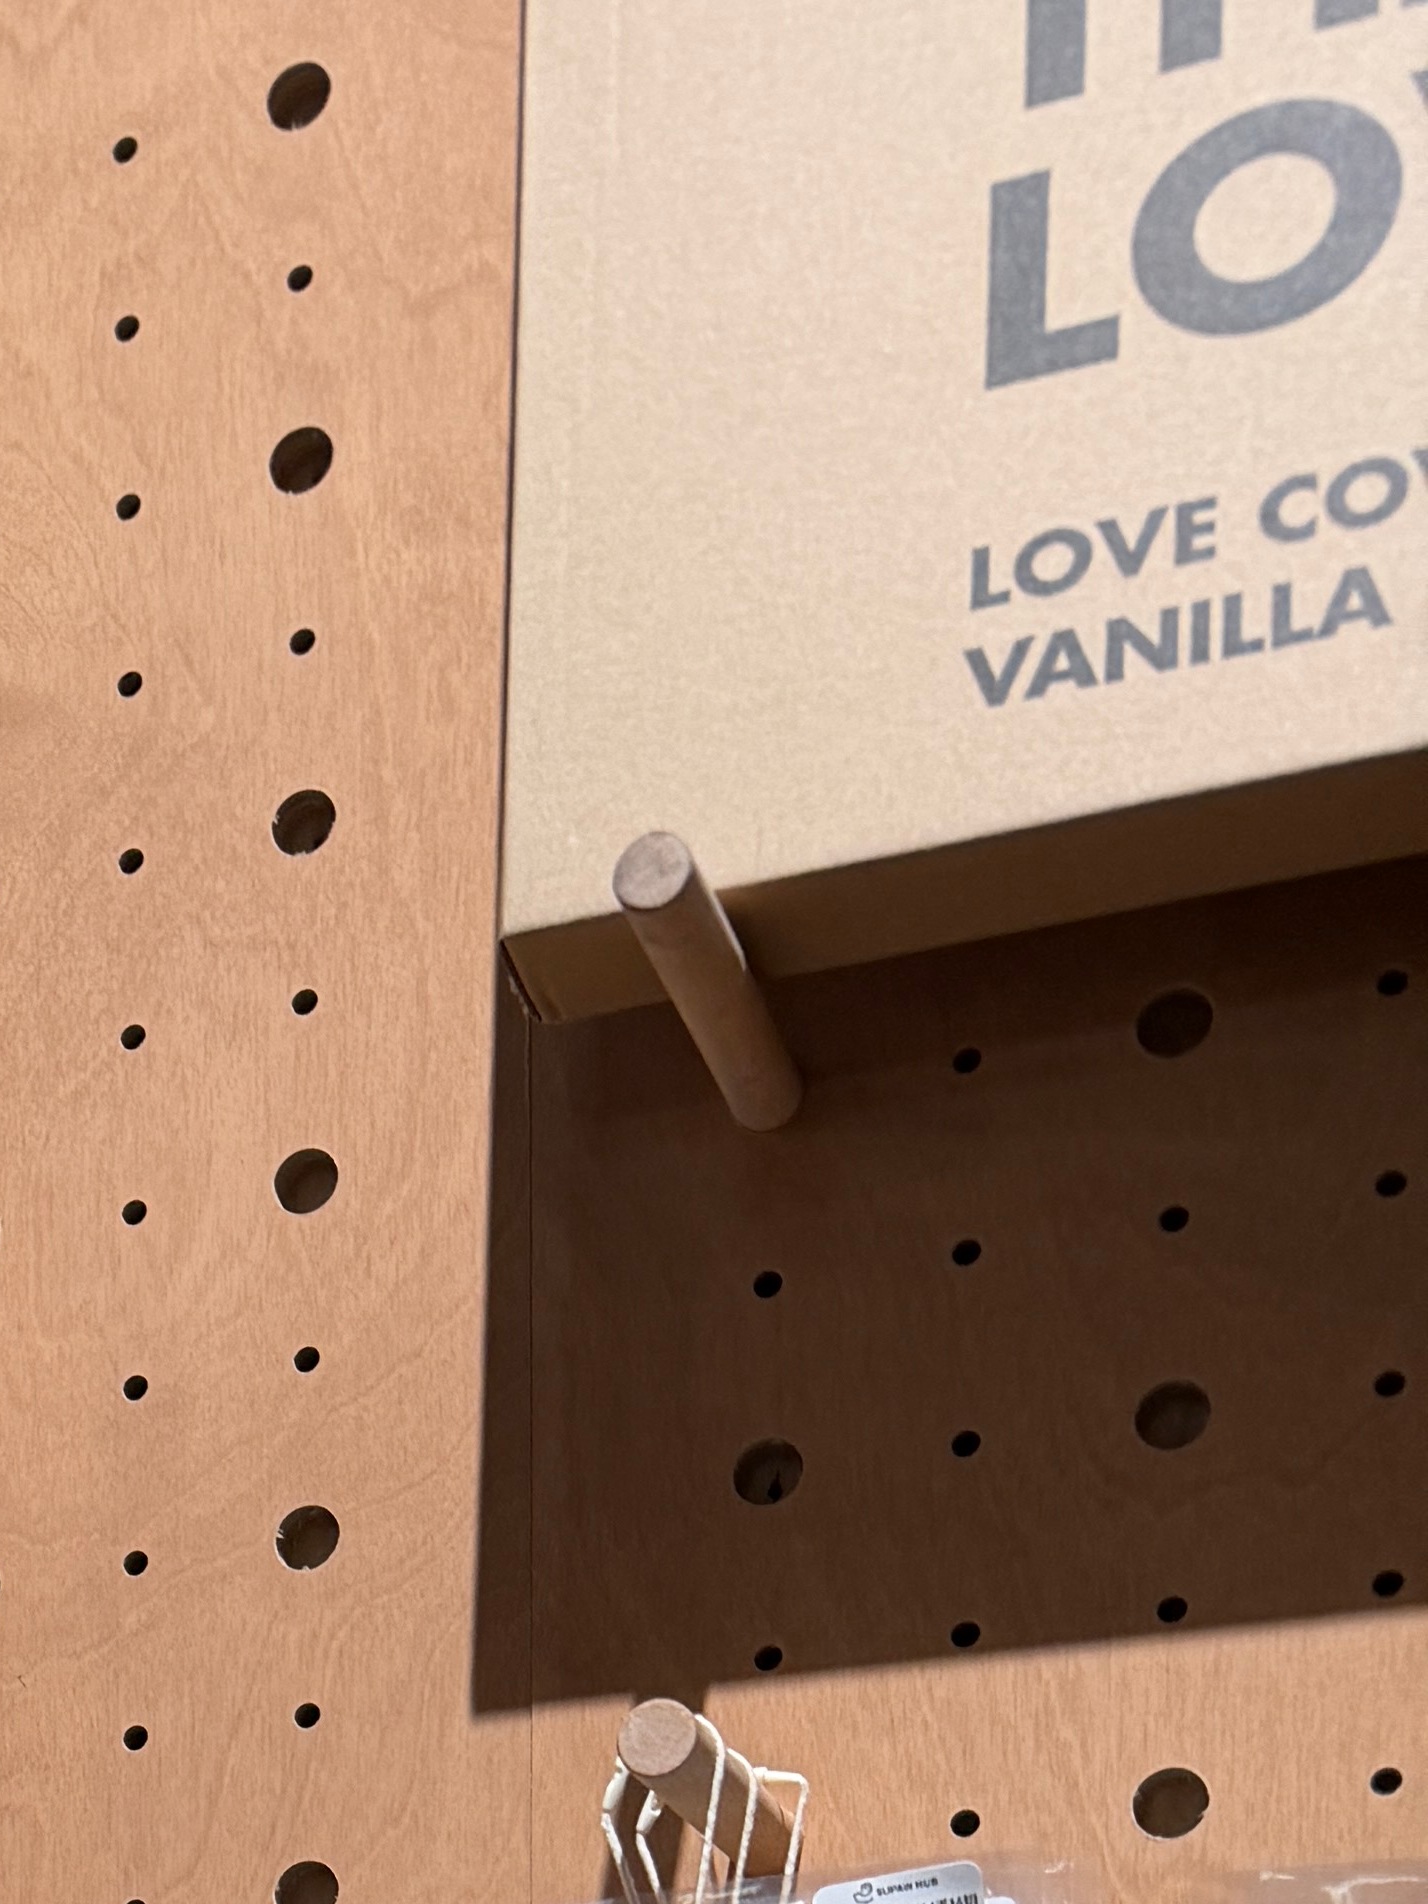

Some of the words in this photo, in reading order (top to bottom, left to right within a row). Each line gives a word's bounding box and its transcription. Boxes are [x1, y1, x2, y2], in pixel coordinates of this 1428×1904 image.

[985, 70, 1428, 389] LO
[969, 498, 1218, 611] LOVE
[1259, 449, 1428, 542] CO
[965, 567, 1393, 707] VANILLA
